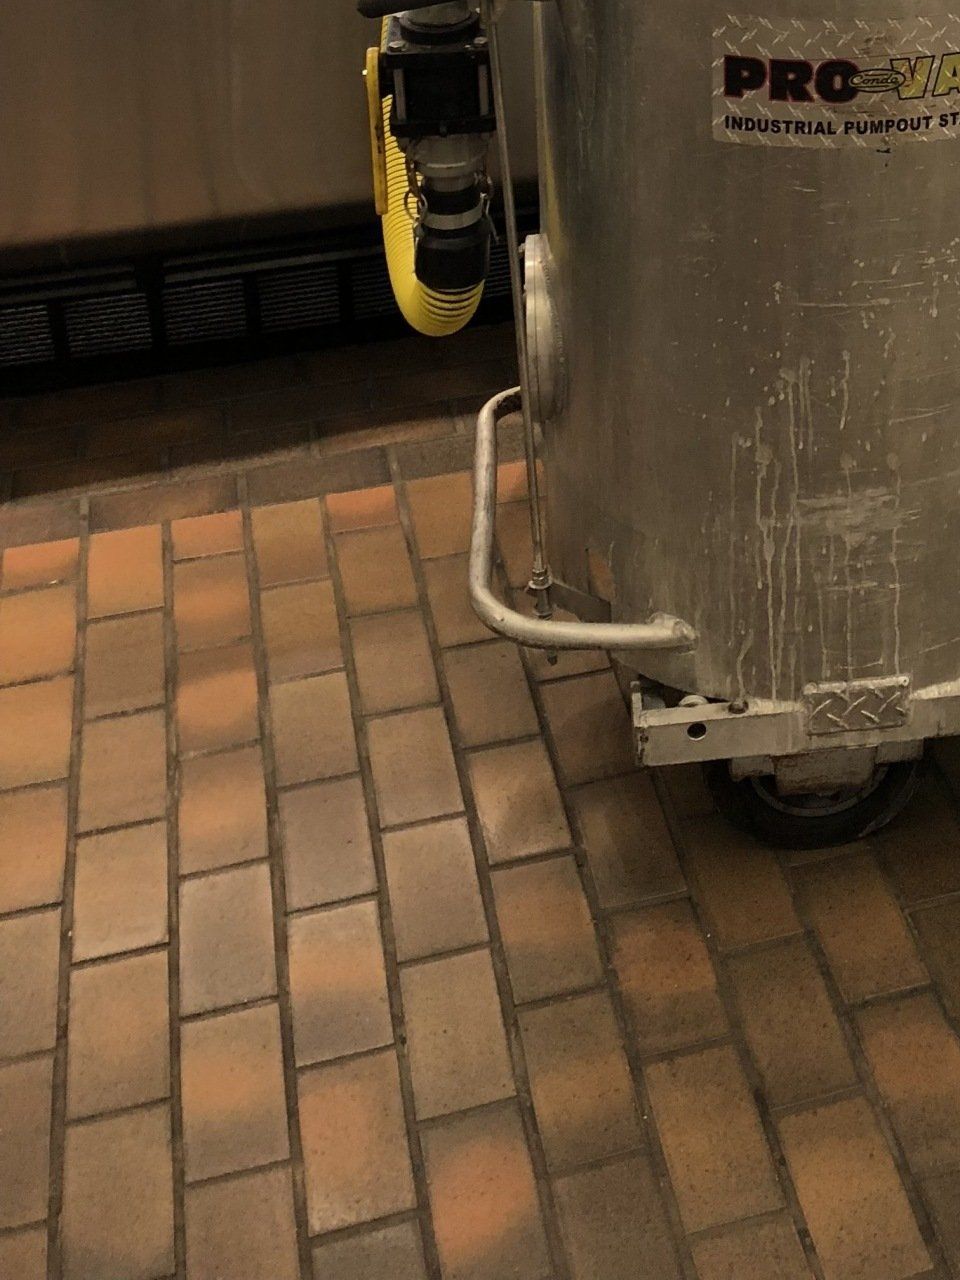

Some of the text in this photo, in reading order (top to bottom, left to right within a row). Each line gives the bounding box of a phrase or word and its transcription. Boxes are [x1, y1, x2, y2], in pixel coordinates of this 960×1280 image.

[723, 54, 860, 104] PRO
[724, 115, 837, 135] INDUSTRIAL
[844, 115, 933, 135] PUMPOUT
